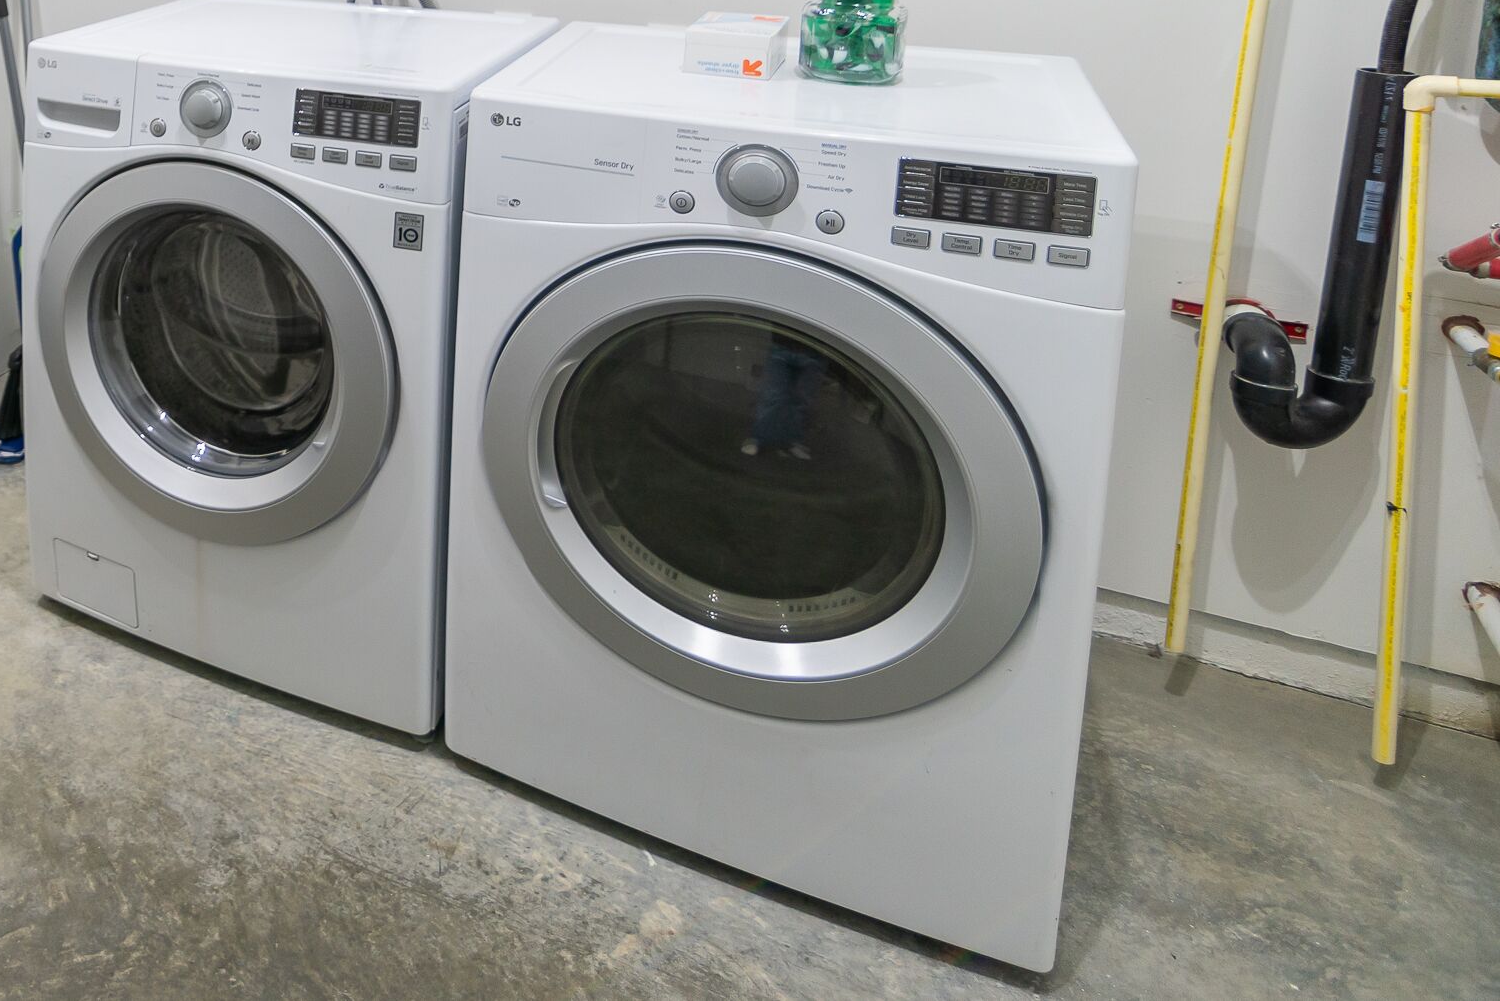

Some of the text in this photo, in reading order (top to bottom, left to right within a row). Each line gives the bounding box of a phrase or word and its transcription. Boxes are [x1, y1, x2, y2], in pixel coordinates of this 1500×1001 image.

[47, 60, 57, 68] LG
[506, 116, 521, 126] LG
[594, 158, 634, 171] Sensor Dry
[398, 227, 418, 243] 10
[1058, 252, 1078, 260] Signal
